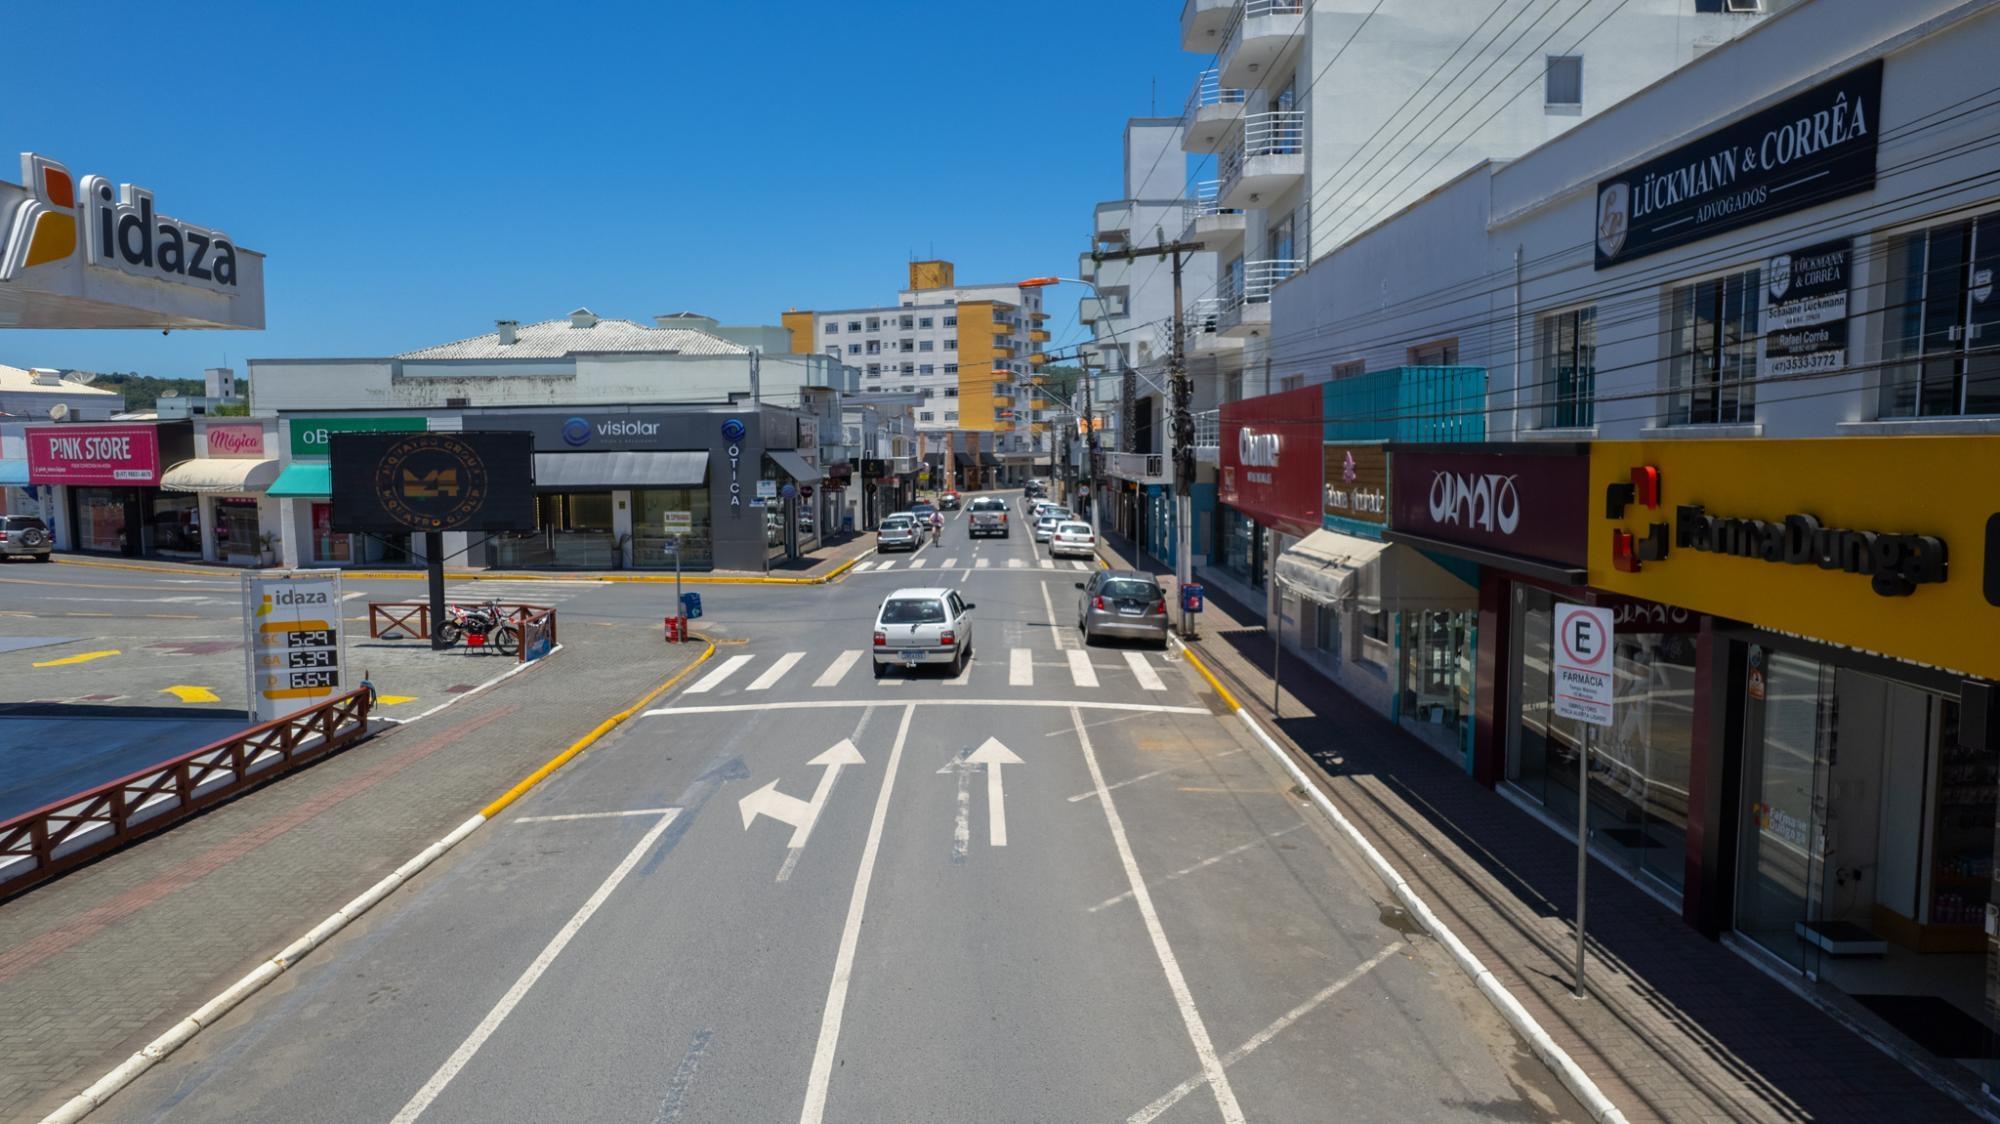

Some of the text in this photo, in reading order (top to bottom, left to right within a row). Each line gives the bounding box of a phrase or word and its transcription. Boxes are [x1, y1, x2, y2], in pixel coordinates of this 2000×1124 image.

[1633, 92, 1867, 218] LÜCKMANN & CORRÊA
[1696, 185, 1768, 224] ADVOGADOS
[101, 186, 237, 286] idaza
[1795, 276, 1803, 288] &
[597, 420, 660, 436] visiolar
[85, 437, 131, 460] STORE
[211, 430, 257, 453] Mágica
[728, 444, 740, 506] ÓTICA
[1429, 470, 1520, 535] ORNATO
[276, 590, 327, 605] idaza
[289, 631, 328, 647] 5.29
[1575, 621, 1591, 654] E
[290, 651, 329, 667] 5.39
